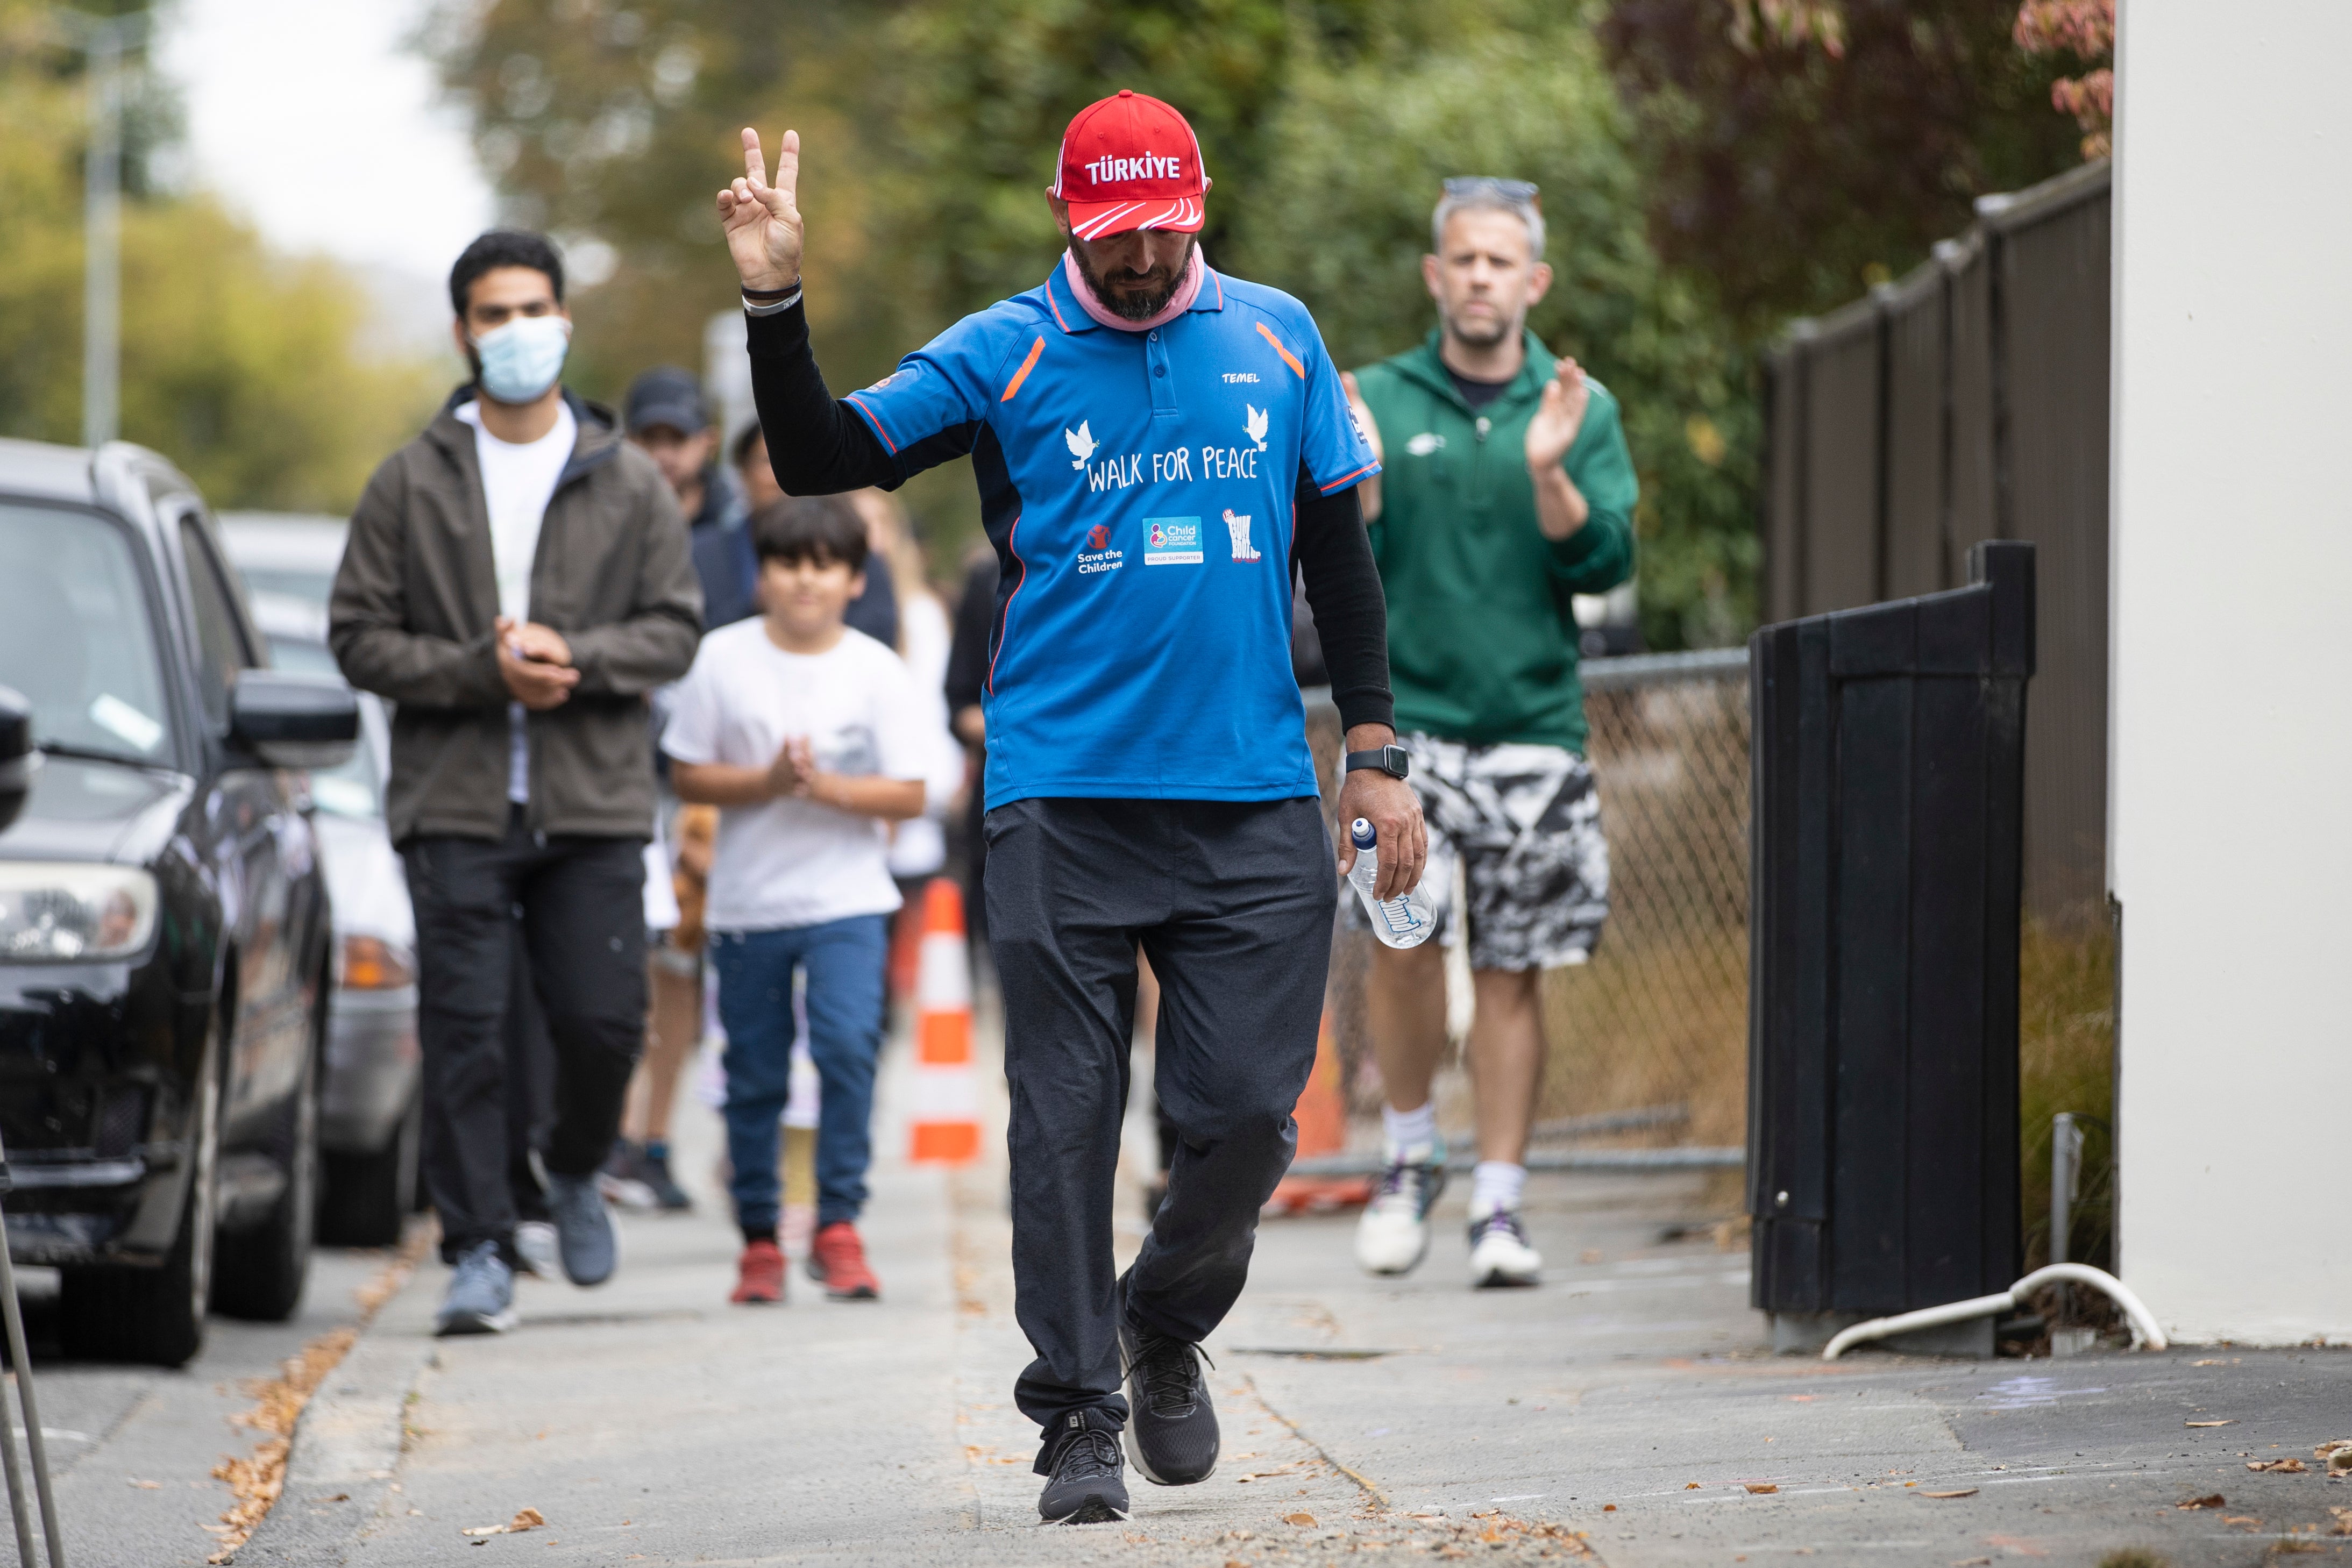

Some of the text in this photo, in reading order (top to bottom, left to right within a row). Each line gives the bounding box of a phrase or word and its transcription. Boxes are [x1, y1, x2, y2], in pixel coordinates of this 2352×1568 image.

[1085, 151, 1180, 186] TÜRKİYE
[1221, 373, 1260, 383] TEMEL
[1087, 446, 1257, 493] WALK FOR PEACE
[1167, 525, 1196, 536] Child
[1228, 515, 1252, 540] GUM
[1077, 549, 1123, 563] Save the
[1078, 561, 1123, 574] Children
